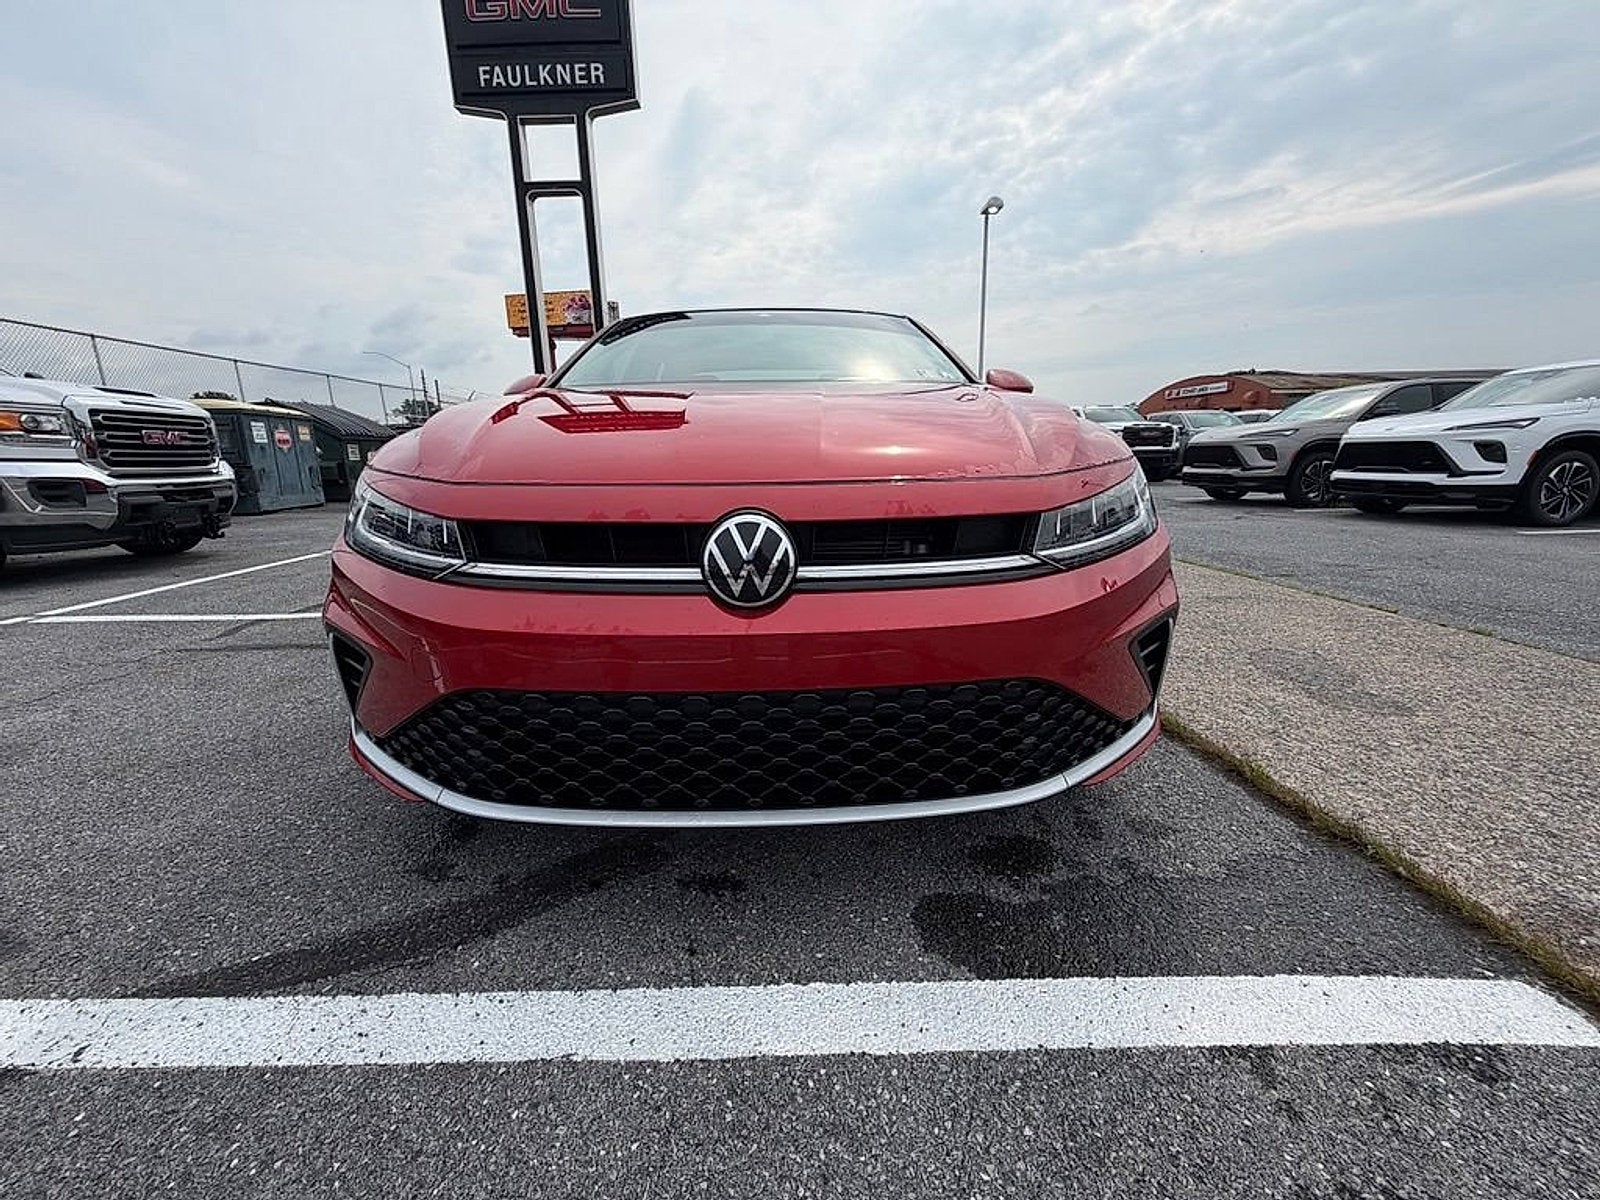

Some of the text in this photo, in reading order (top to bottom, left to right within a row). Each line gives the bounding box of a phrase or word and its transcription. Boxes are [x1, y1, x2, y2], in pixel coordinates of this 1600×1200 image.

[478, 62, 605, 87] FAULKNER
[141, 429, 190, 445] GMC
[706, 515, 790, 600] VW
